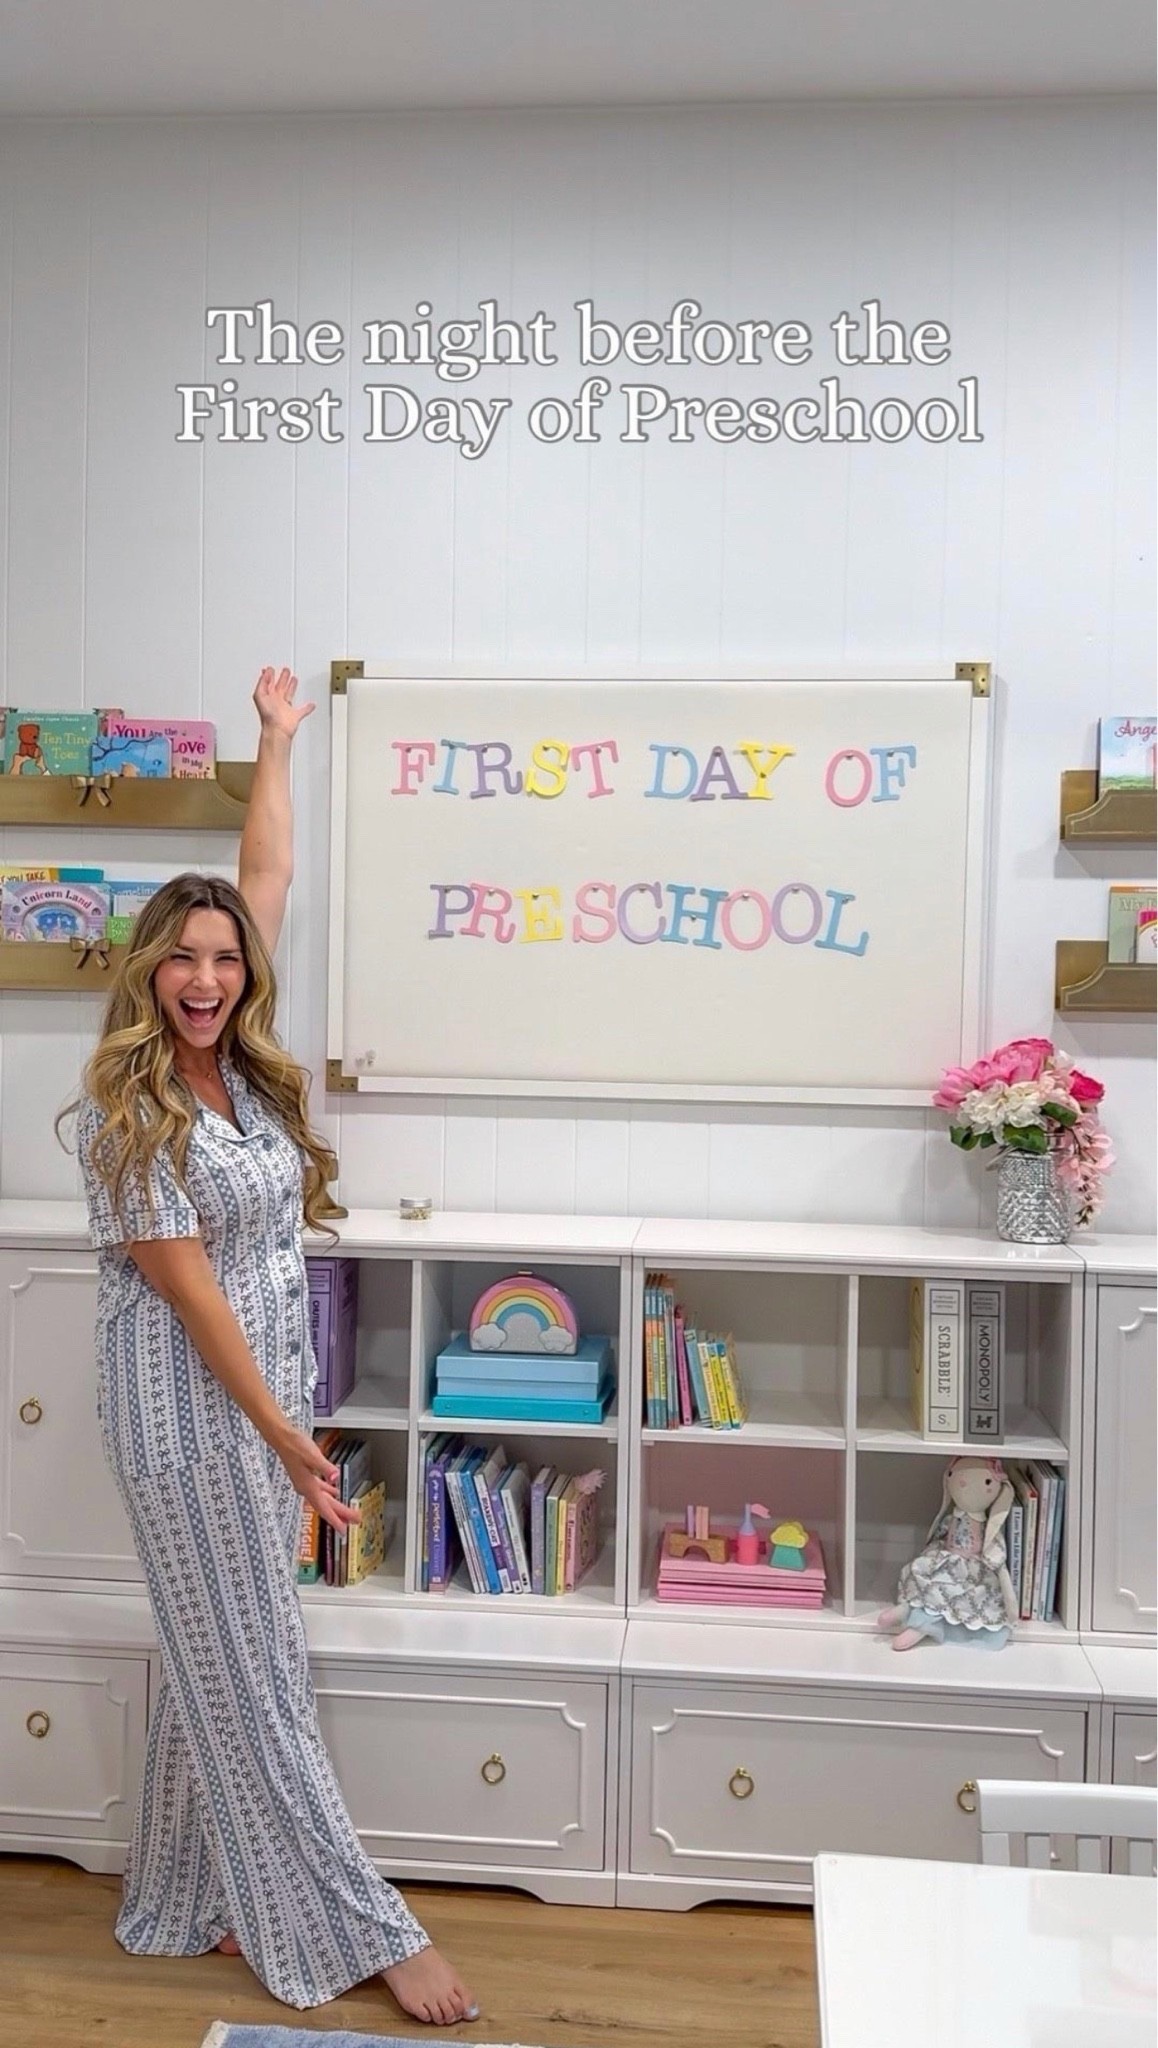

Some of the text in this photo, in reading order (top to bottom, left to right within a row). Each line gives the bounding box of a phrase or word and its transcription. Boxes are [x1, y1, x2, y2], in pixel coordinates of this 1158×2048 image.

[42, 732, 91, 747] Ten Tiny
[115, 725, 146, 738] You
[164, 728, 178, 736] the
[52, 747, 79, 760] Toes
[171, 738, 206, 754] Love
[190, 759, 203, 768] My
[390, 738, 917, 808] FIRST DAY OF
[26, 872, 46, 882] TAKE
[22, 890, 92, 909] Unicorn Land
[428, 881, 869, 957] PRESCHOOL
[938, 1325, 951, 1394] SCRABBLE
[978, 1324, 991, 1402] MONOPOLY
[300, 1512, 315, 1562] BIGGIE!
